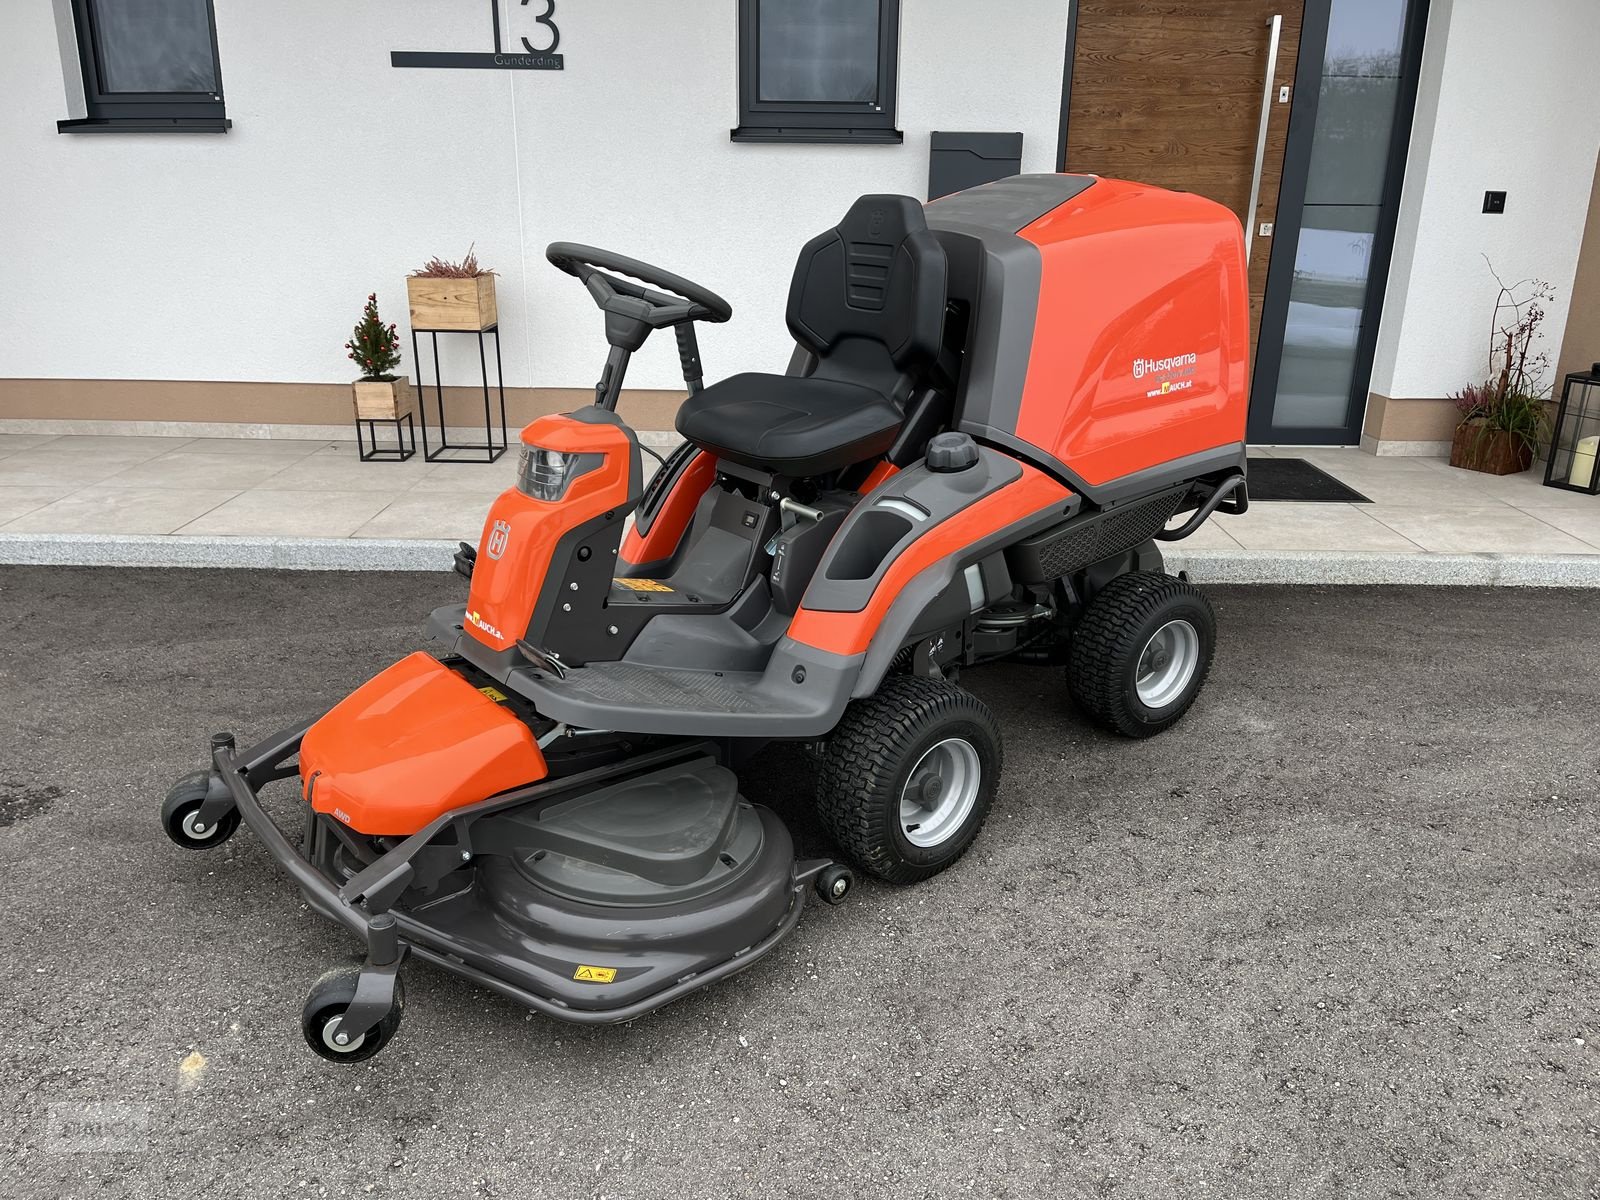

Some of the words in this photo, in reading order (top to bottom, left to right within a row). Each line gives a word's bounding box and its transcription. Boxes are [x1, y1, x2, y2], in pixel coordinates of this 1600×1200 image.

[494, 54, 561, 69] Gunderding
[1145, 353, 1196, 373] Husqvarna
[334, 808, 351, 824] AWD
